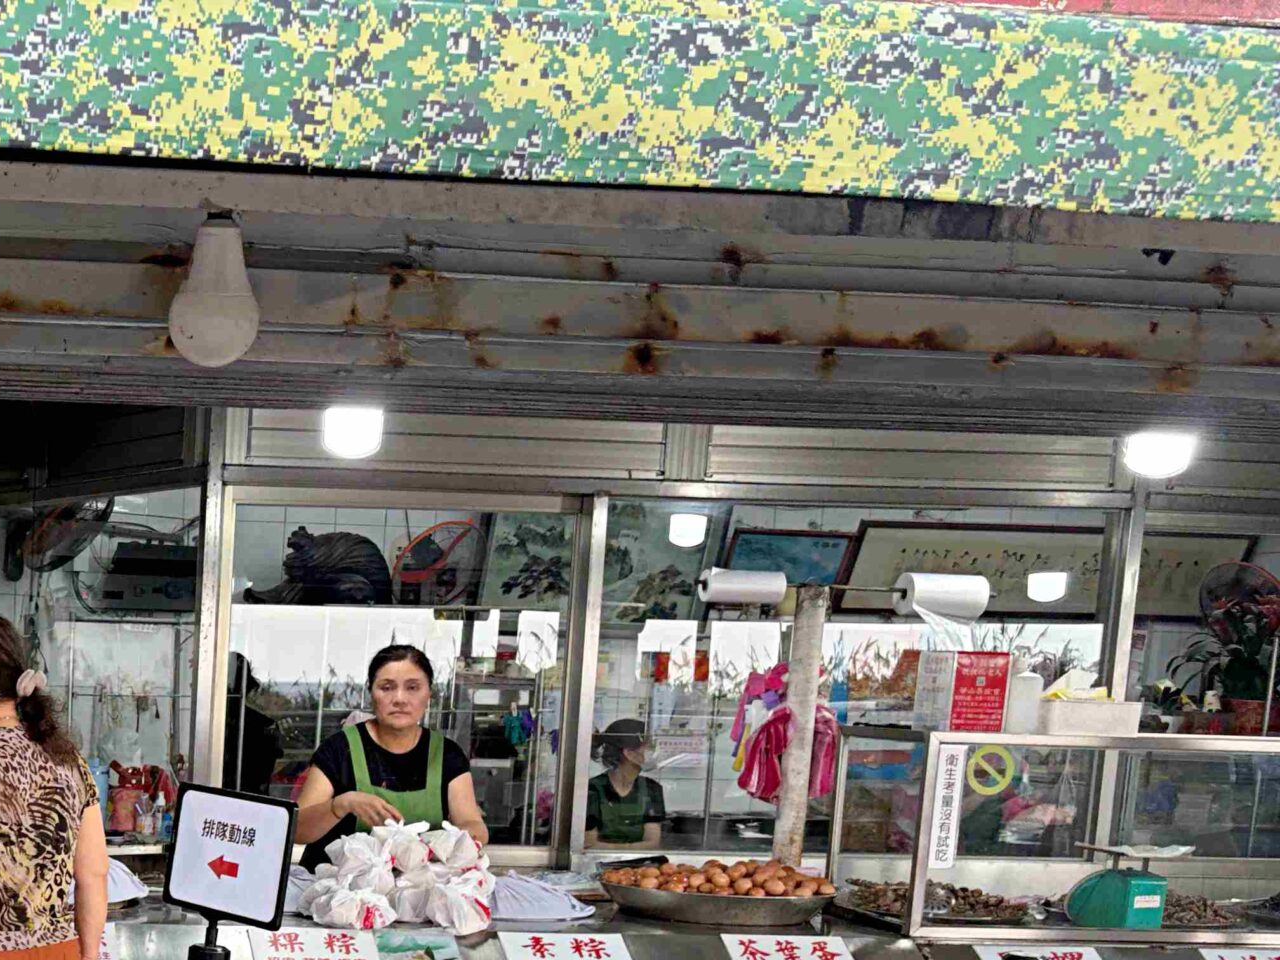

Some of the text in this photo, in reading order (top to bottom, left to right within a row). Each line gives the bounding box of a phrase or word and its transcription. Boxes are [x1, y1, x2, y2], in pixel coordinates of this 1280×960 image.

[934, 753, 959, 863] 衛生考量沒有試吃
[201, 818, 257, 847] 排隊動線
[268, 932, 359, 955] 粿粽
[521, 936, 611, 959] 素粽
